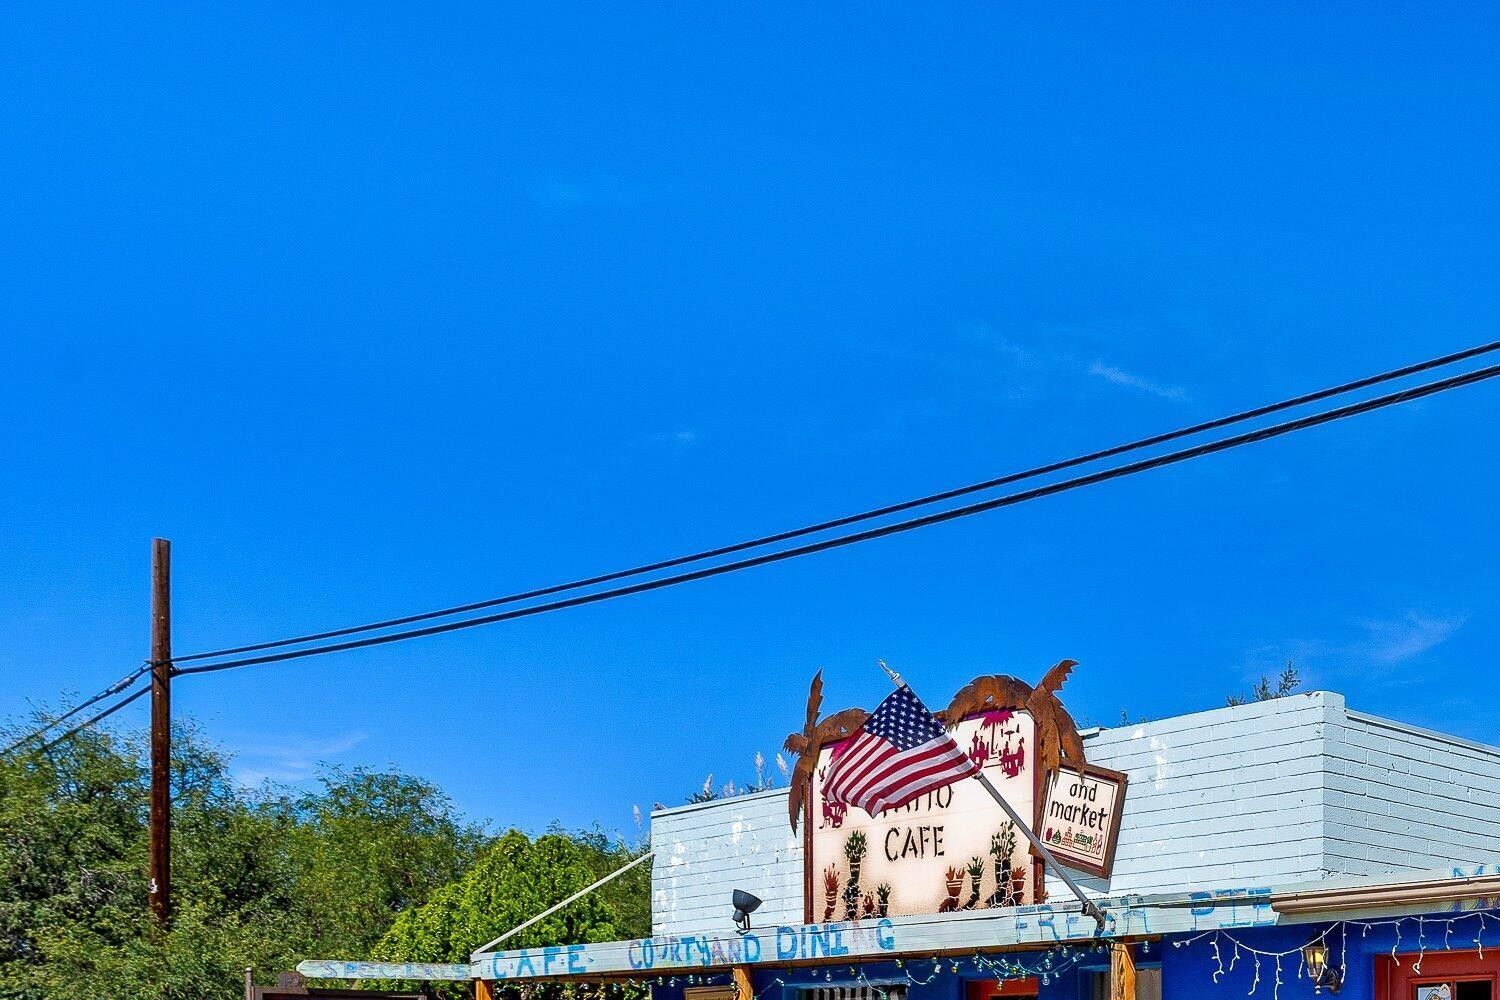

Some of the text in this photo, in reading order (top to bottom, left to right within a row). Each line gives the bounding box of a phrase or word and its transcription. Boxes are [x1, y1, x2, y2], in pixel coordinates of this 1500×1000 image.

[1070, 783, 1098, 802] and
[1049, 800, 1108, 831] market
[885, 826, 945, 862] CAFE
[777, 918, 896, 960] DINIG
[493, 944, 586, 979] CAFE
